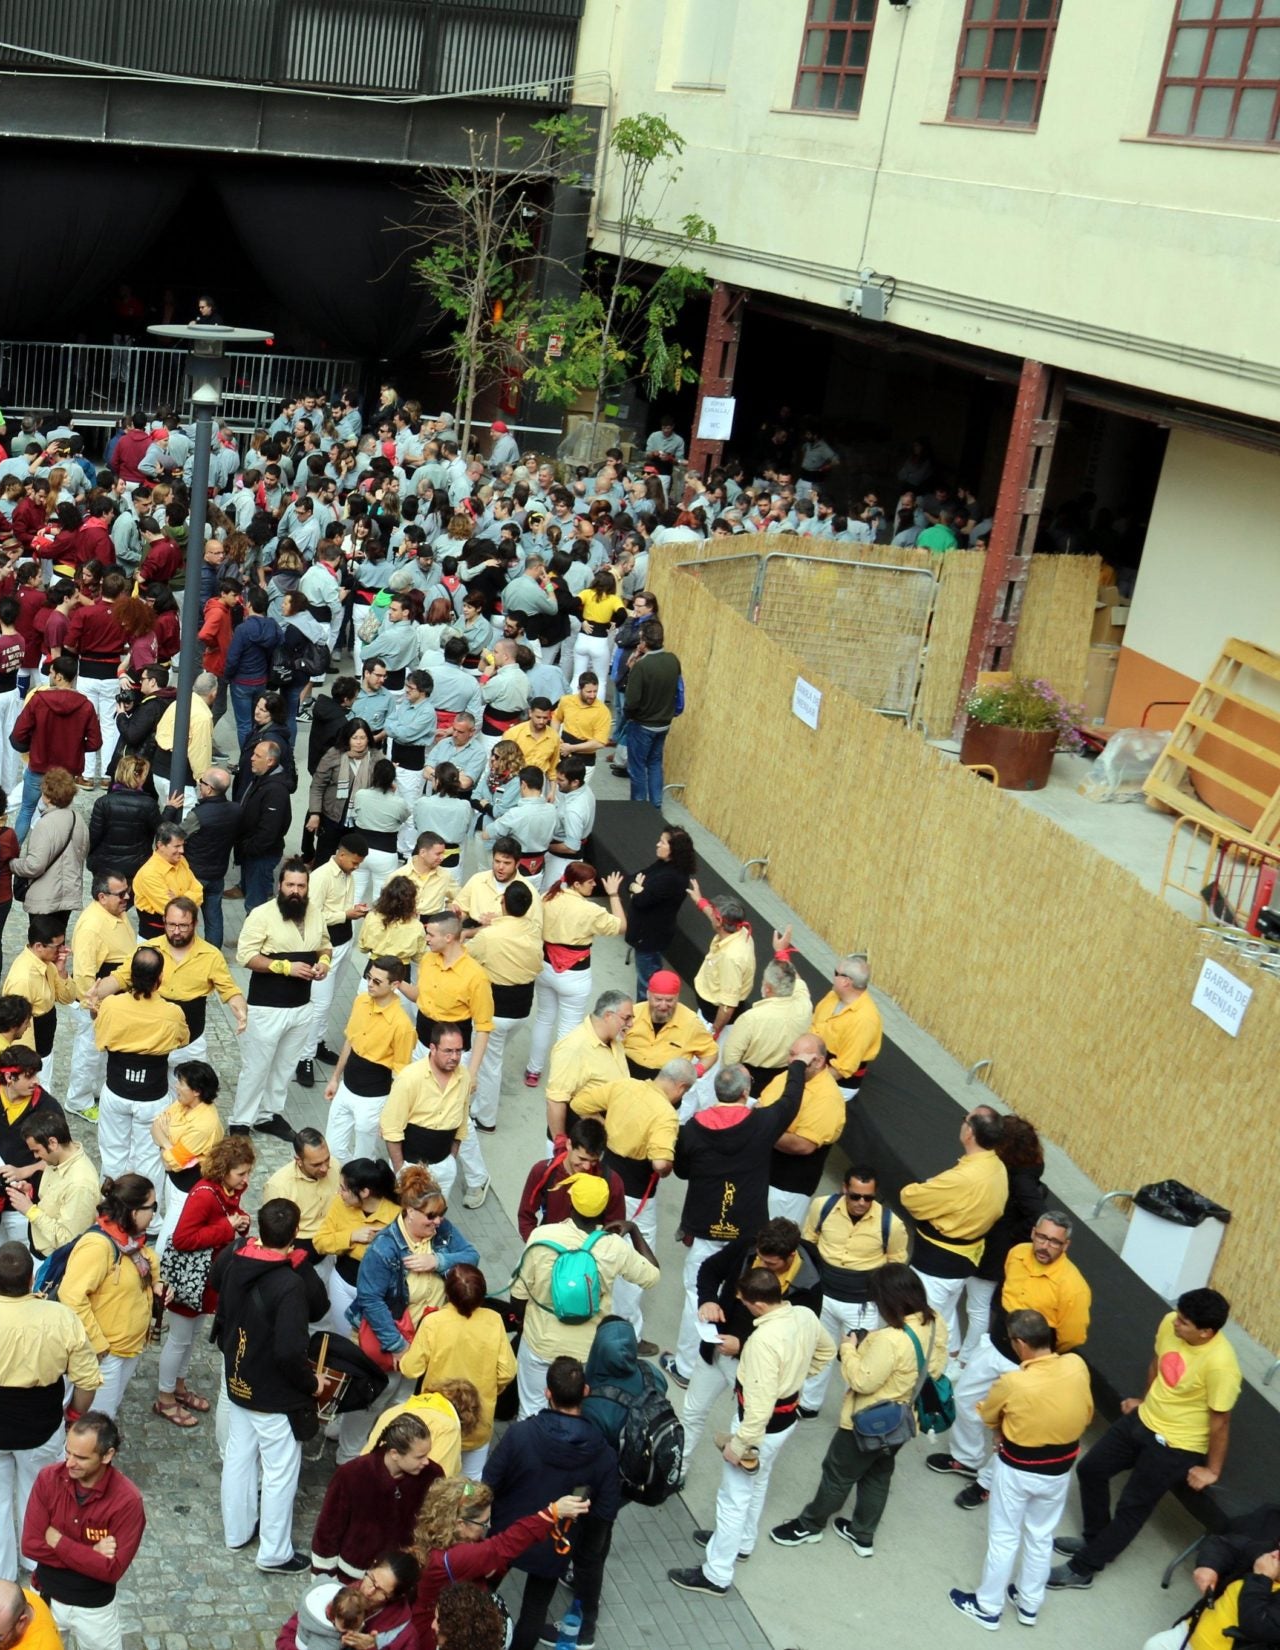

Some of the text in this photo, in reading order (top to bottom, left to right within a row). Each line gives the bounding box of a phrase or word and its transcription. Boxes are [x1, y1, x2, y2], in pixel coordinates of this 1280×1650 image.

[1202, 986, 1239, 1021] MENJAR
[1203, 967, 1249, 1007] BARRA DE
